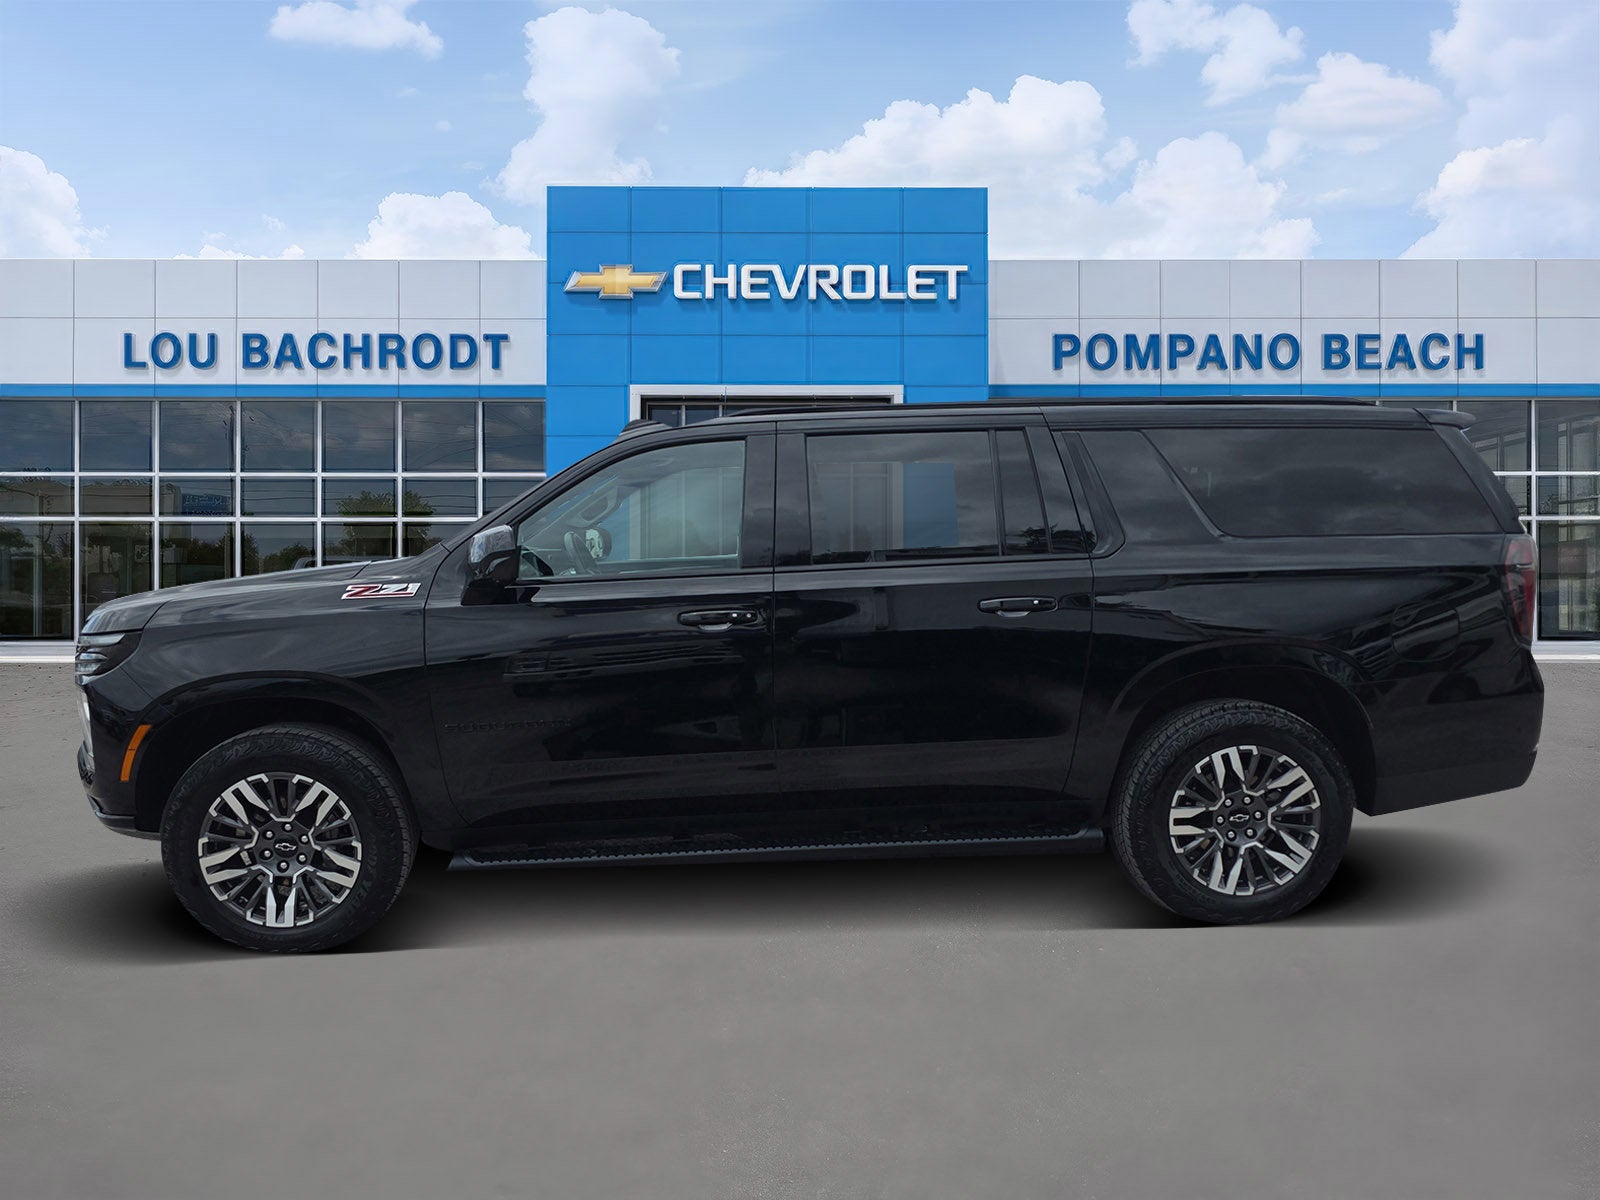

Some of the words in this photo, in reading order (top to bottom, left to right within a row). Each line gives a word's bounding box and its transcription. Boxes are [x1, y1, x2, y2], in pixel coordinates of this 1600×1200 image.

[672, 263, 968, 301] CHEVROLET
[123, 332, 217, 370] LOU
[242, 332, 510, 370] BACHRODT
[1053, 333, 1301, 371] POMPANO
[1323, 333, 1484, 371] BEACH
[341, 582, 421, 600] Z71
